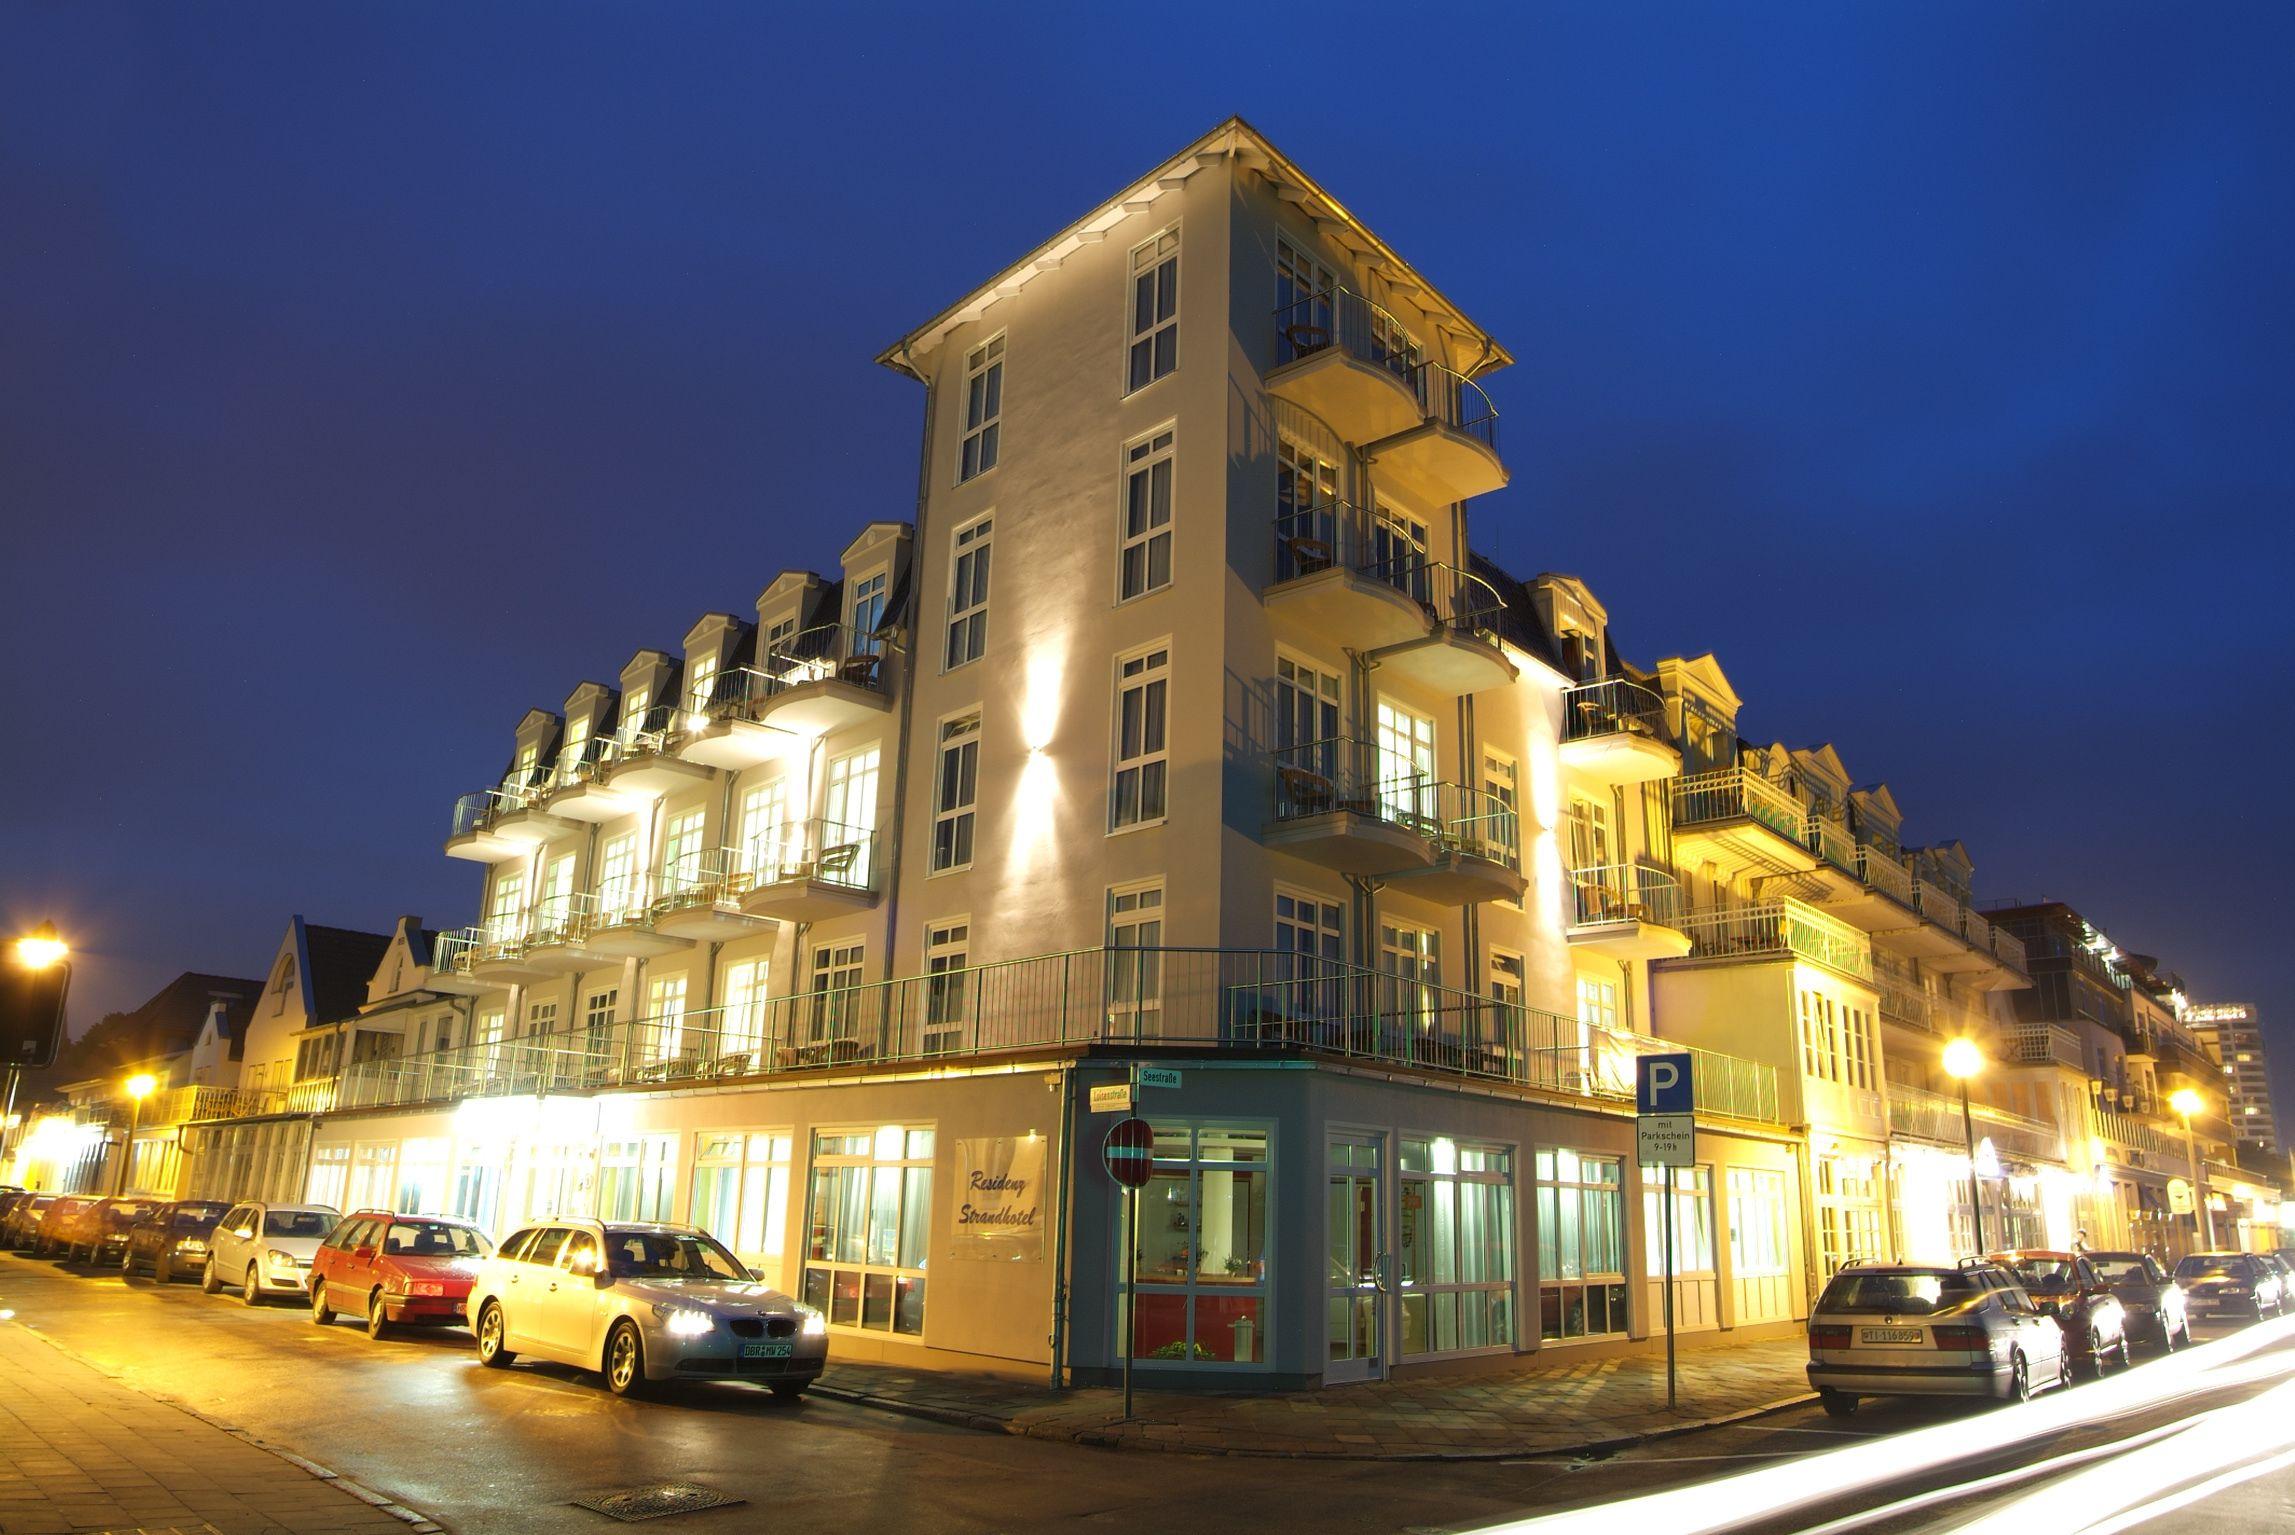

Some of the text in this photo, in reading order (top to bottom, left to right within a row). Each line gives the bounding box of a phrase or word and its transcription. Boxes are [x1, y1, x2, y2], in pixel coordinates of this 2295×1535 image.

[1143, 1070, 1177, 1085] Seestraße
[1649, 1062, 1679, 1106] P
[1657, 1121, 1672, 1129] mit
[1641, 1131, 1690, 1141] Parkschein
[970, 1170, 1026, 1198] Residenz
[959, 1203, 1037, 1226] Strandhotel
